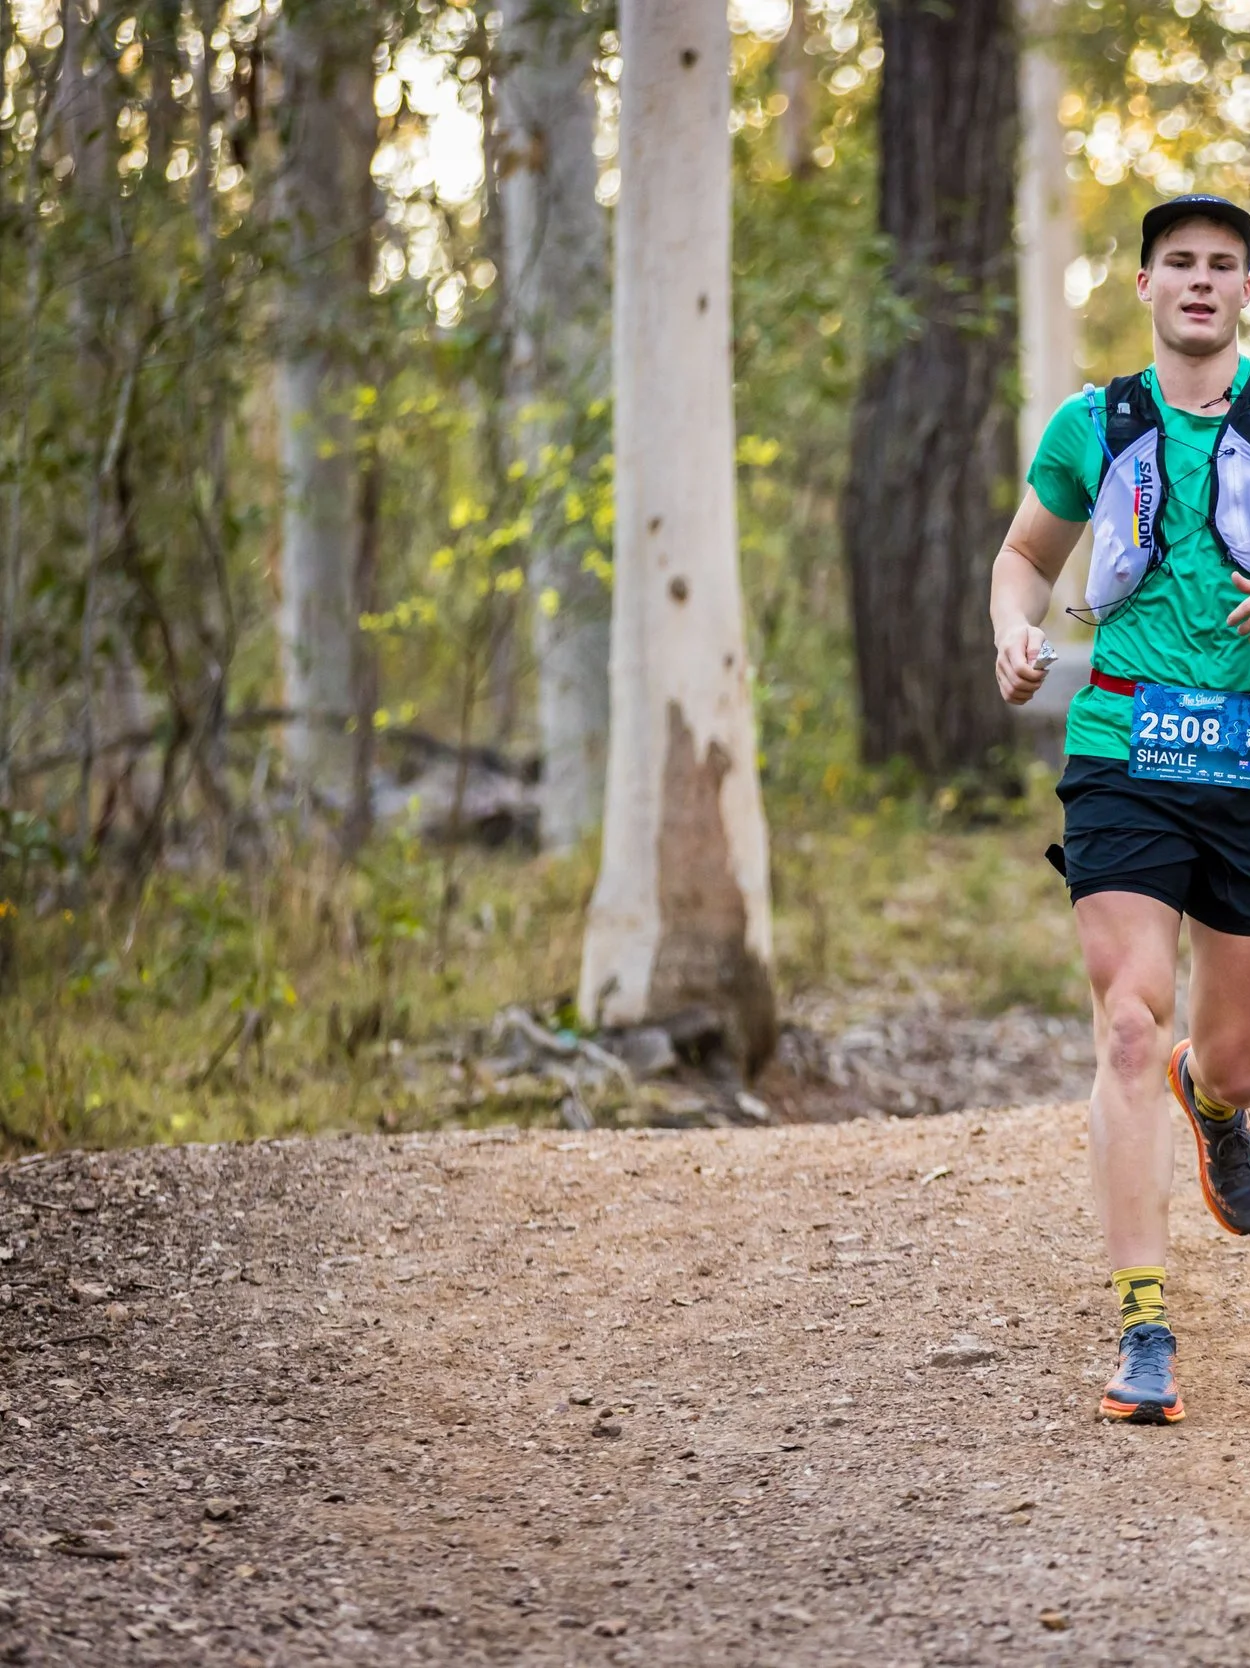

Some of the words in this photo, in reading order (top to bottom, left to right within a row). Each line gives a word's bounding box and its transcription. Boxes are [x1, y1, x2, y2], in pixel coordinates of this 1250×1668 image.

[1138, 460, 1153, 549] SALOMON
[1178, 693, 1195, 707] The
[1139, 711, 1220, 745] 2508
[1136, 748, 1197, 767] SHAYLE
